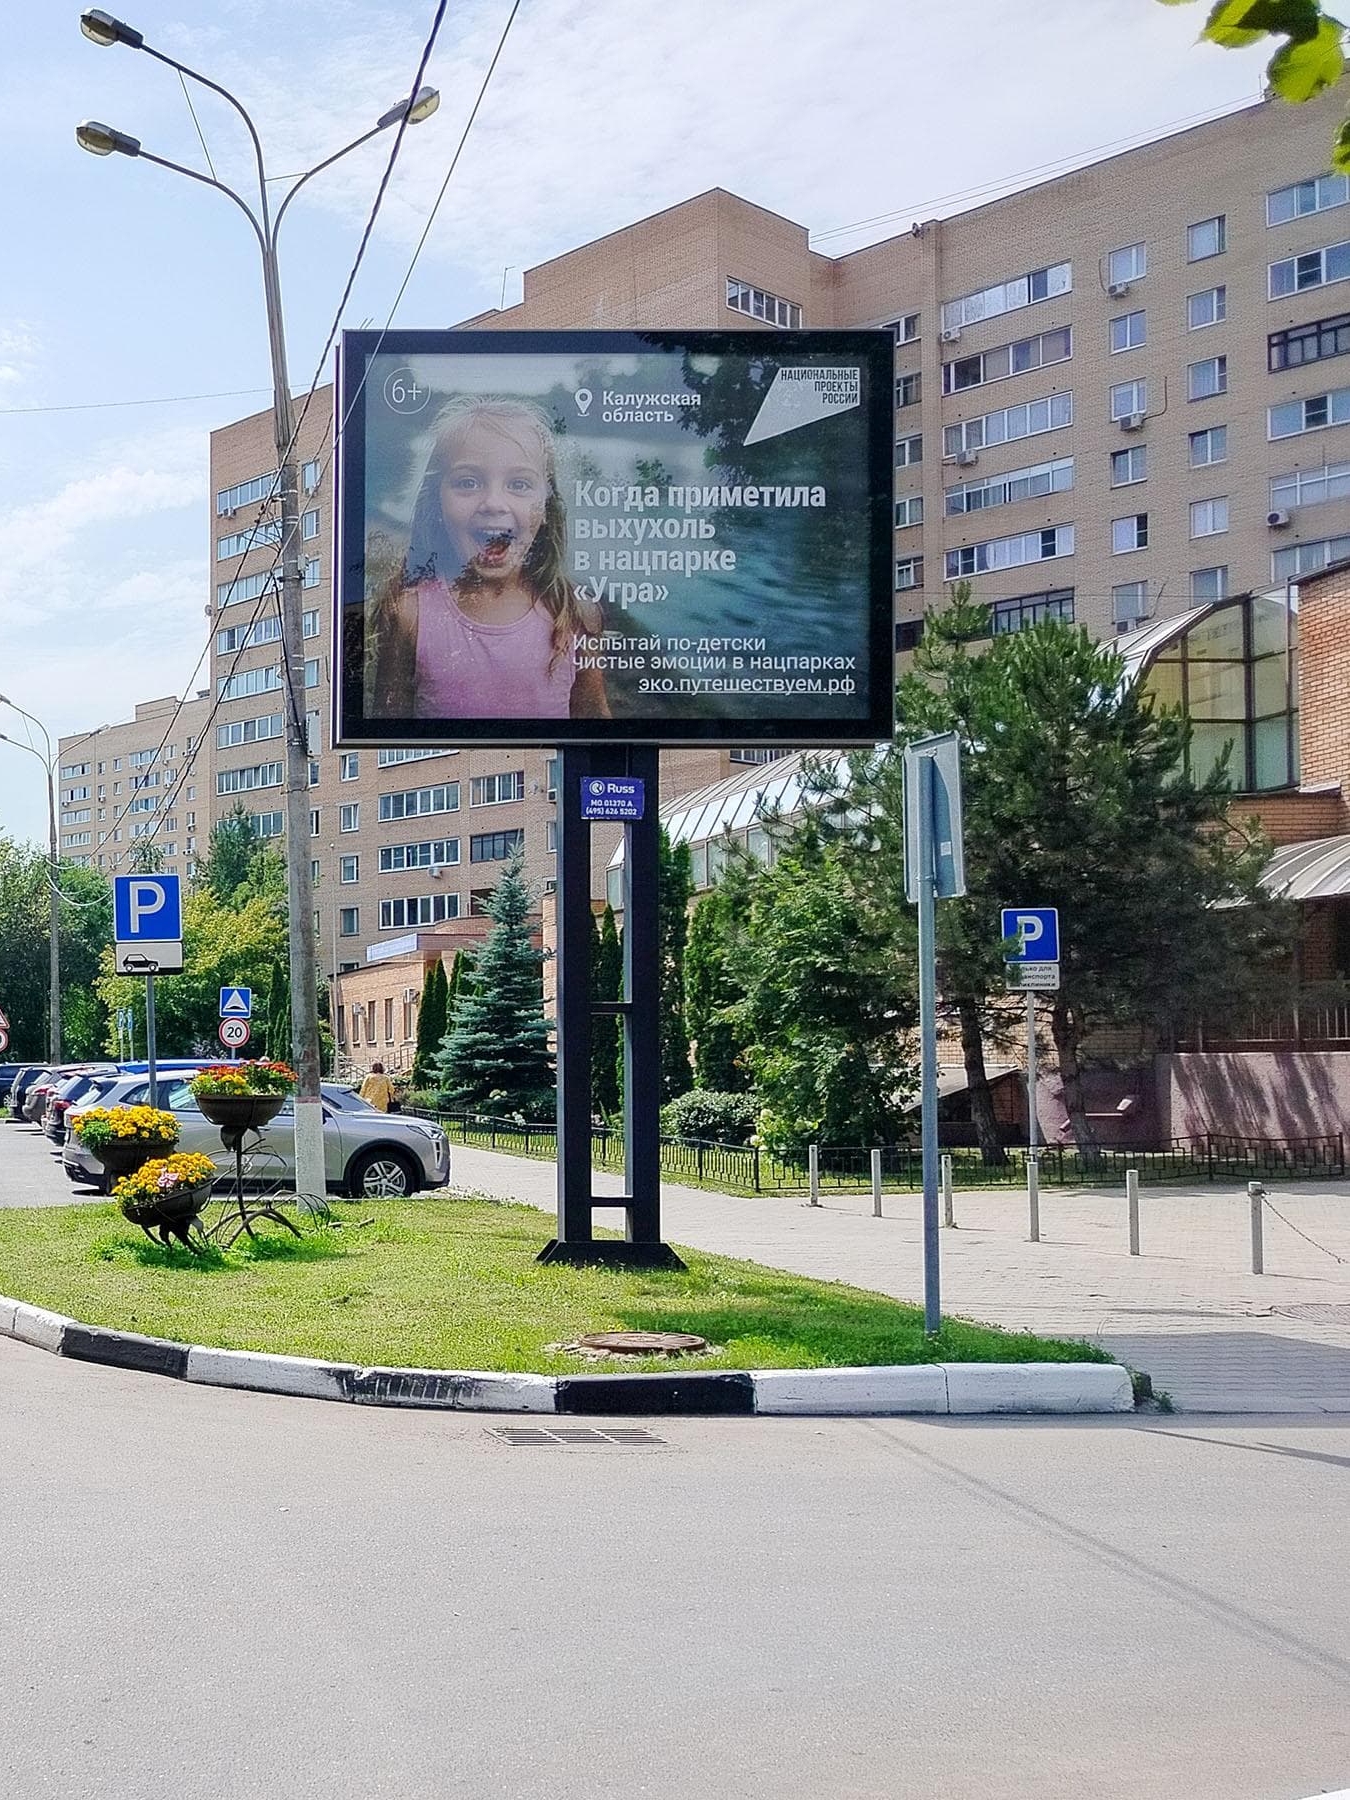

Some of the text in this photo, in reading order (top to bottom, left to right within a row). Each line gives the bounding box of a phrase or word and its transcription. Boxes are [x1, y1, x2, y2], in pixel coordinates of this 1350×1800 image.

[780, 369, 859, 381] НАЦИОНАЛЬНЫЕ
[391, 378, 422, 404] 6+
[814, 381, 859, 392] ПРОЕКТЫ
[602, 390, 702, 408] Калужская
[822, 392, 858, 404] РОССИИ
[602, 408, 674, 422] область
[574, 480, 826, 513] Когда приметила
[574, 518, 716, 546] выхухоль
[574, 549, 736, 577] в нацпарке
[573, 576, 669, 609] «Угра»
[573, 634, 766, 654] Испытай по-детски
[573, 655, 856, 672] чистые эмоции в нацпарках
[638, 675, 856, 696] эко.путешествуем.рф
[607, 783, 635, 794] Russ
[586, 807, 604, 815] (495)
[129, 881, 166, 934] P
[1017, 915, 1044, 956] P
[226, 1026, 242, 1038] 20
